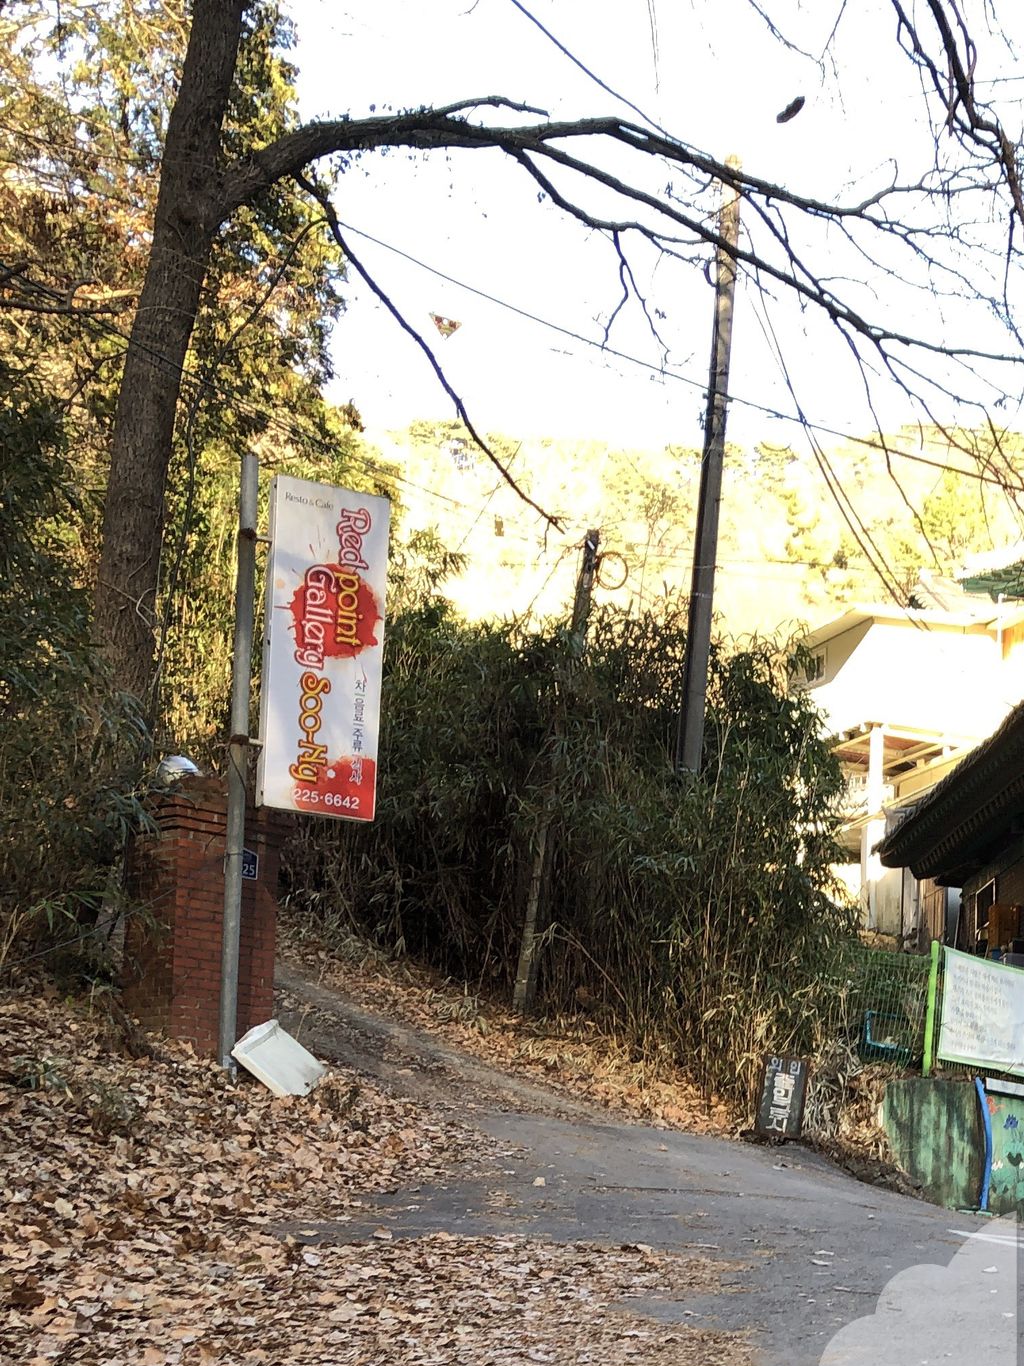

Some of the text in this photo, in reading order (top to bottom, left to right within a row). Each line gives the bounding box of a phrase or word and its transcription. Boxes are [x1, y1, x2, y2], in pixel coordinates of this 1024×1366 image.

[335, 507, 372, 647] Red point
[289, 564, 338, 784] Gallery Soo-Ny
